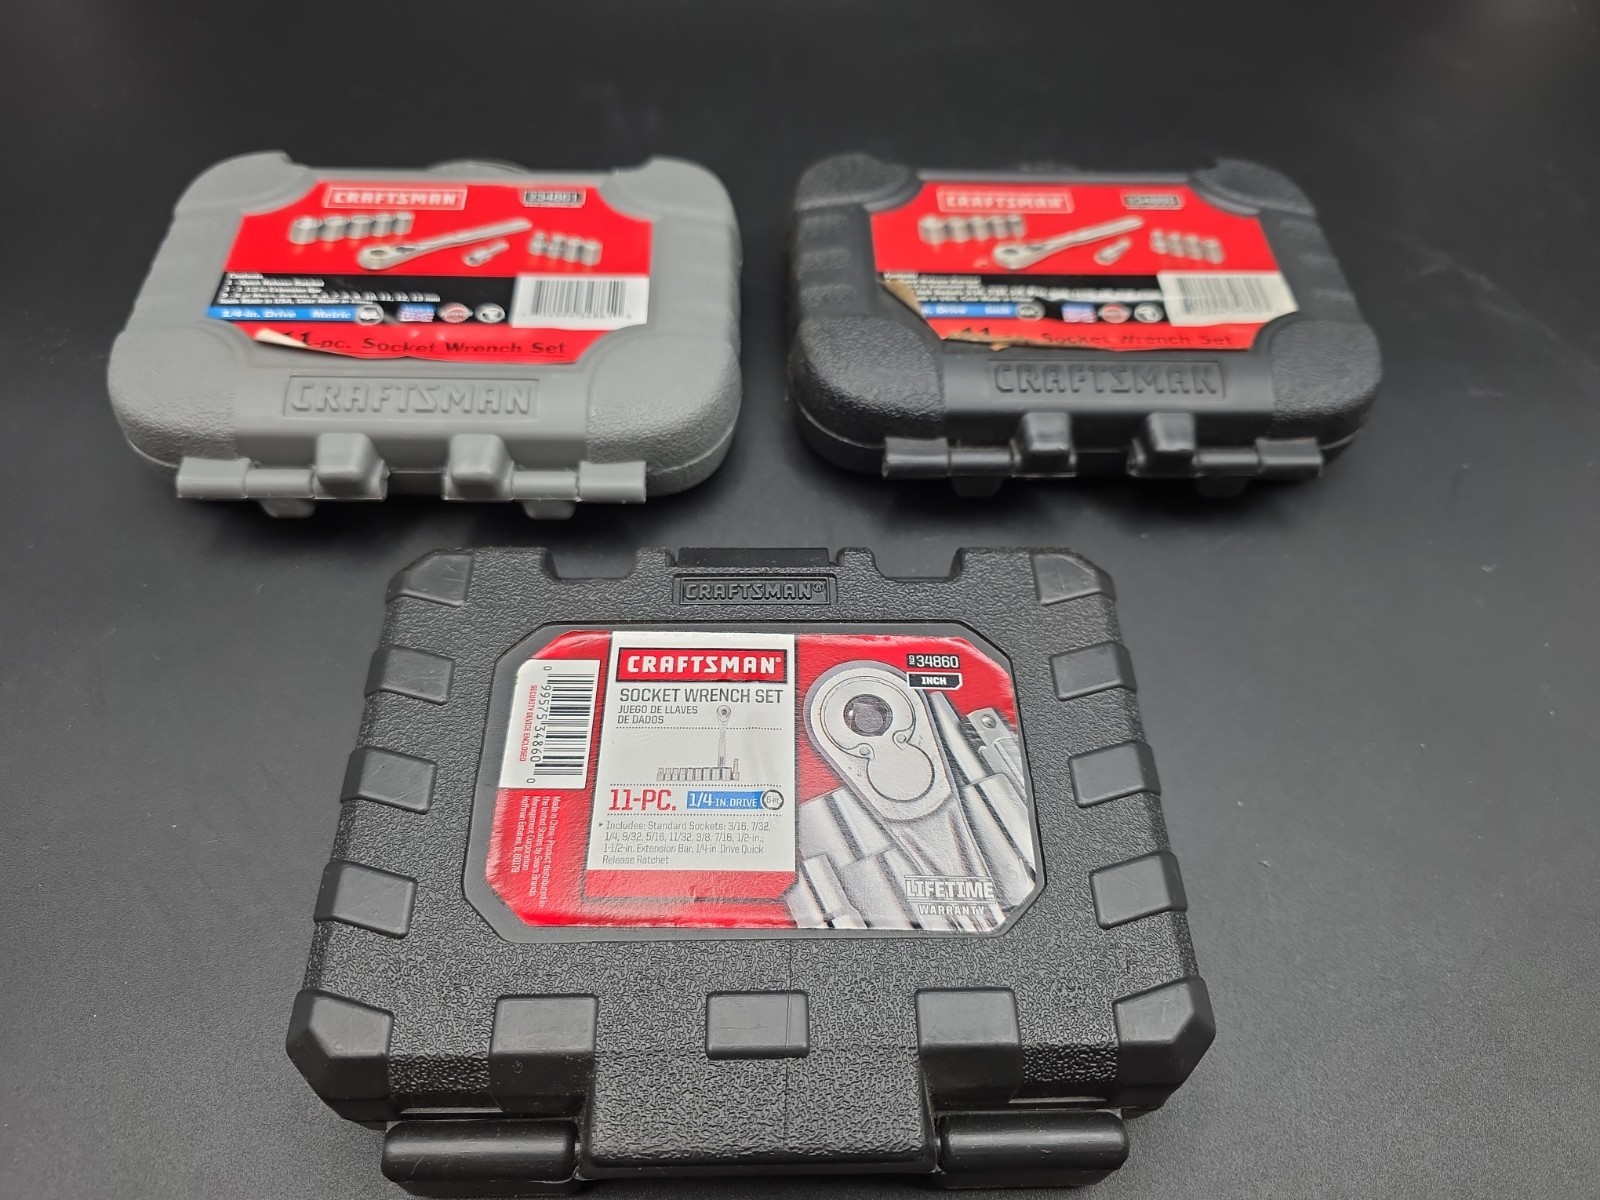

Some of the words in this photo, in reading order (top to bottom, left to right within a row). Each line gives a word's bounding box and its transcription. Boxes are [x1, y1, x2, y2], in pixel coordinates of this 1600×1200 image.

[334, 191, 457, 206] CRAFTSMAN
[945, 193, 1064, 209] CRAFTSMAN
[221, 309, 261, 319] 1/4-in.
[262, 309, 297, 319] Drive
[311, 309, 352, 319] Metric
[362, 338, 436, 353] Socket
[445, 342, 522, 354] Wrench
[531, 341, 565, 354] Set
[1041, 332, 1108, 344] Socket
[1120, 334, 1190, 346] Wrench
[1198, 334, 1232, 346] Set
[994, 364, 1218, 394] CRAFTSMAN
[291, 381, 532, 415] CRAFTSMAN
[921, 676, 947, 686] INCH
[528, 684, 538, 709] SECURITY
[619, 688, 681, 702] SOCKET
[684, 688, 751, 703] WRENCH
[755, 689, 784, 704] SET
[618, 705, 648, 714] JUEGO
[650, 705, 662, 714] DE
[665, 705, 698, 714] LLAVES
[524, 710, 534, 732] DEVICE
[617, 715, 630, 724] DE
[632, 715, 664, 724] DADOS
[519, 733, 531, 762] ENCLOSED
[608, 788, 677, 811] 11-PC.
[730, 798, 758, 807] DRIVE
[648, 821, 687, 831] Standard
[637, 843, 676, 853] Extension
[721, 844, 739, 854] Drive
[741, 845, 764, 855] Quick
[602, 855, 634, 865] Release
[636, 856, 670, 865] Ratchet
[906, 880, 995, 898] LIFETIME
[918, 904, 985, 916] WARRANTY
